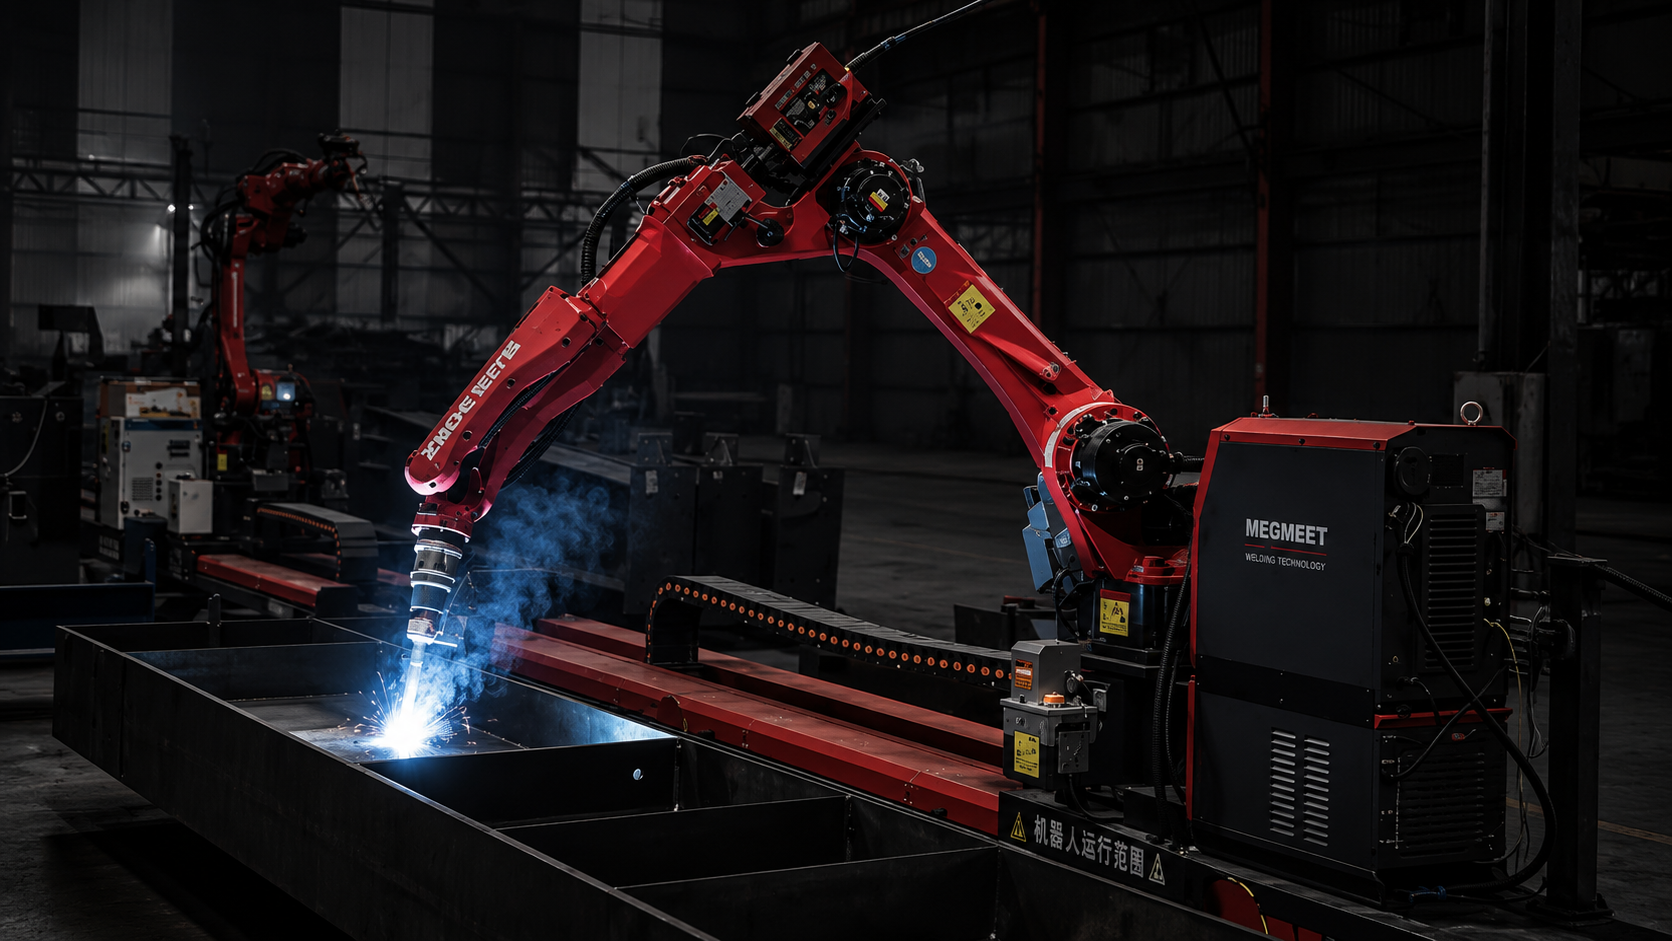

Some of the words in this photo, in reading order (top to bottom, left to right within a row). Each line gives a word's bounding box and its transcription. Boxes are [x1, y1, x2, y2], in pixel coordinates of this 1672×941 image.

[1245, 518, 1328, 546] MEGMEET
[1245, 552, 1276, 565] WELDING
[1277, 556, 1326, 571] TECHNOLOGY
[1034, 814, 1144, 878] 机器人运行范围
